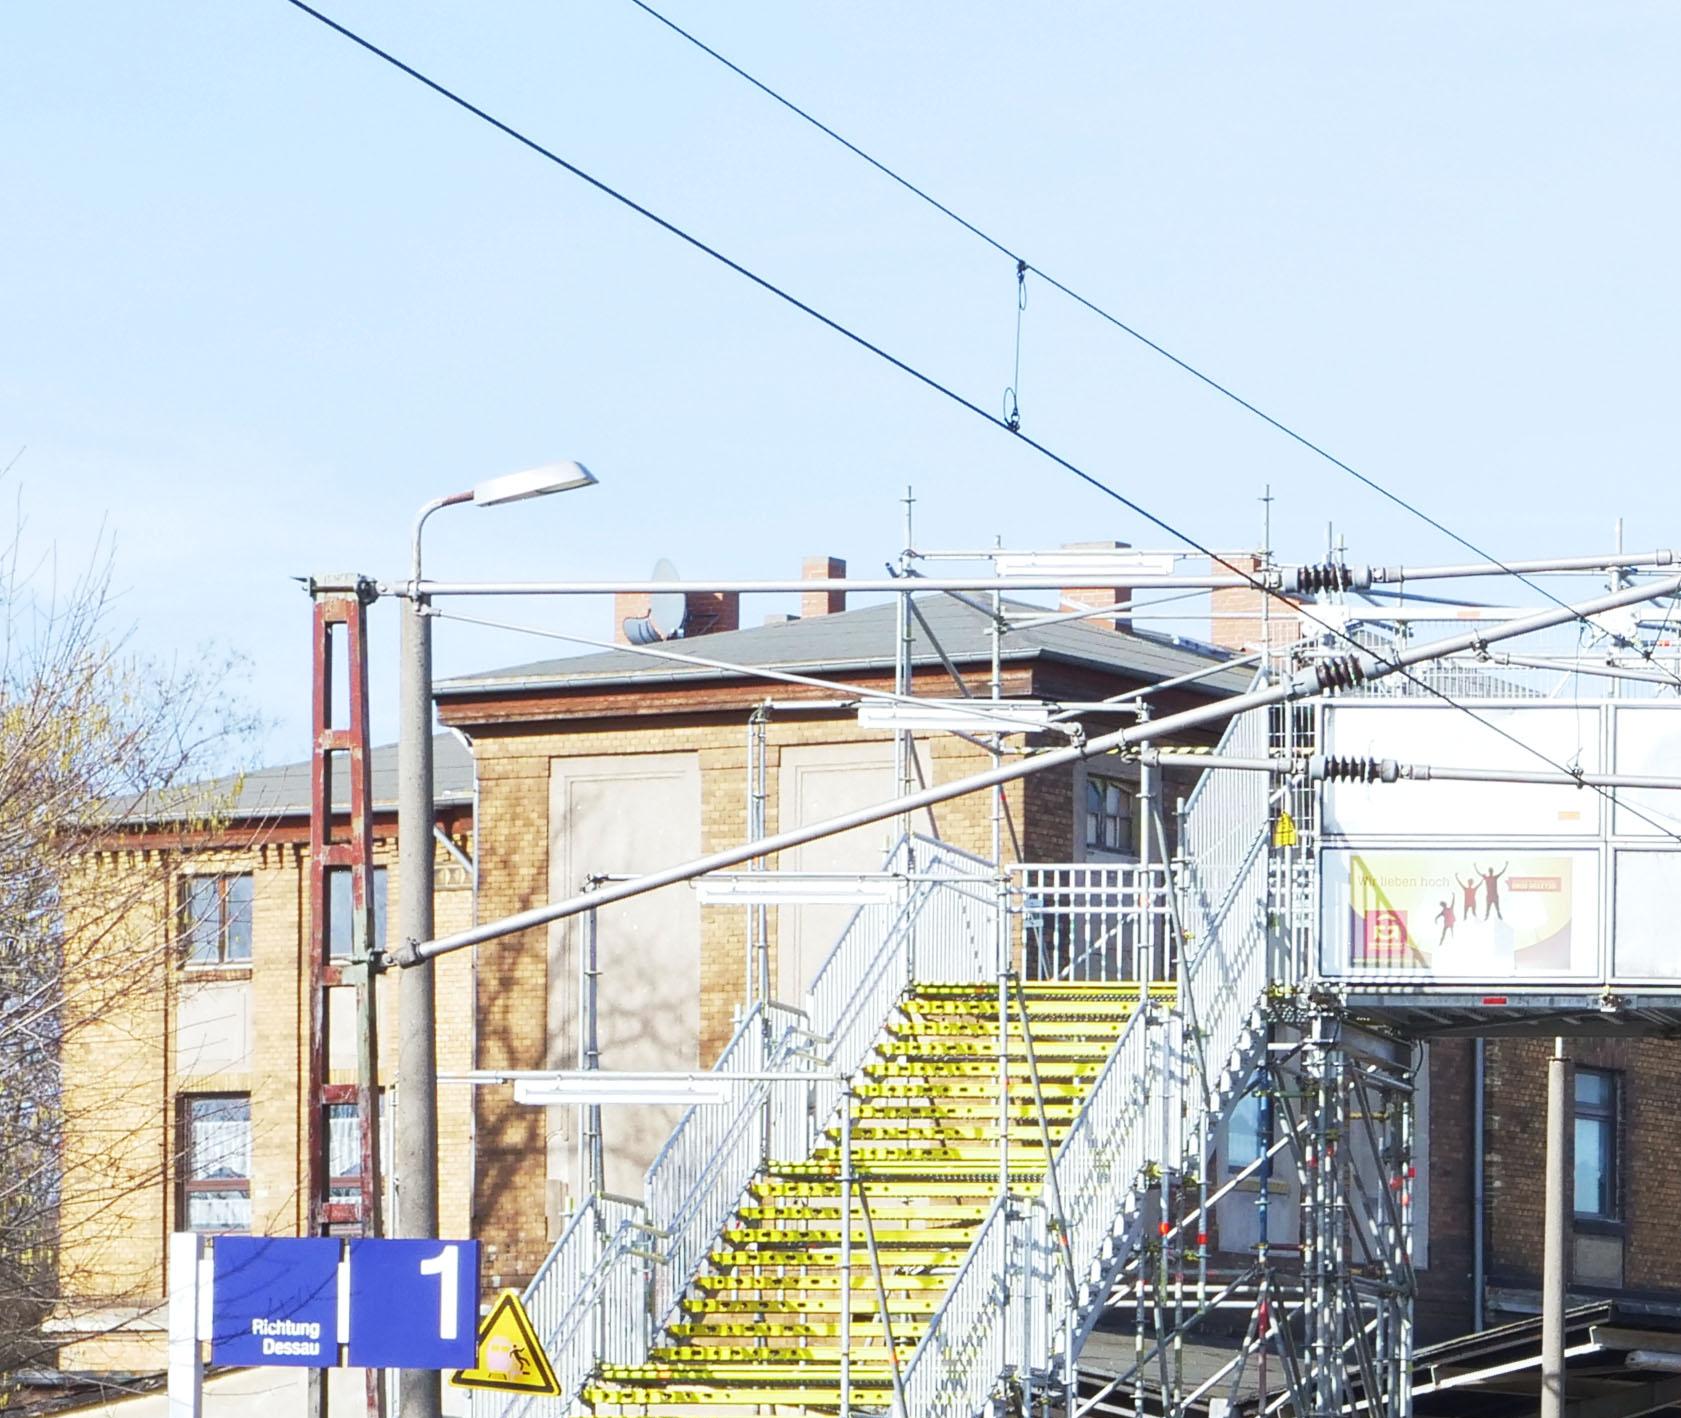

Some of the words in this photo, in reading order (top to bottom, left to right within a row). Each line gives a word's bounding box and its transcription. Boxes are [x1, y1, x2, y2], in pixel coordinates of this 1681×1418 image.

[1381, 875, 1416, 888] lieben
[1420, 875, 1450, 888] hoch
[420, 1245, 459, 1340] 1
[252, 1318, 320, 1338] Richtung
[263, 1339, 320, 1356] Dessau
